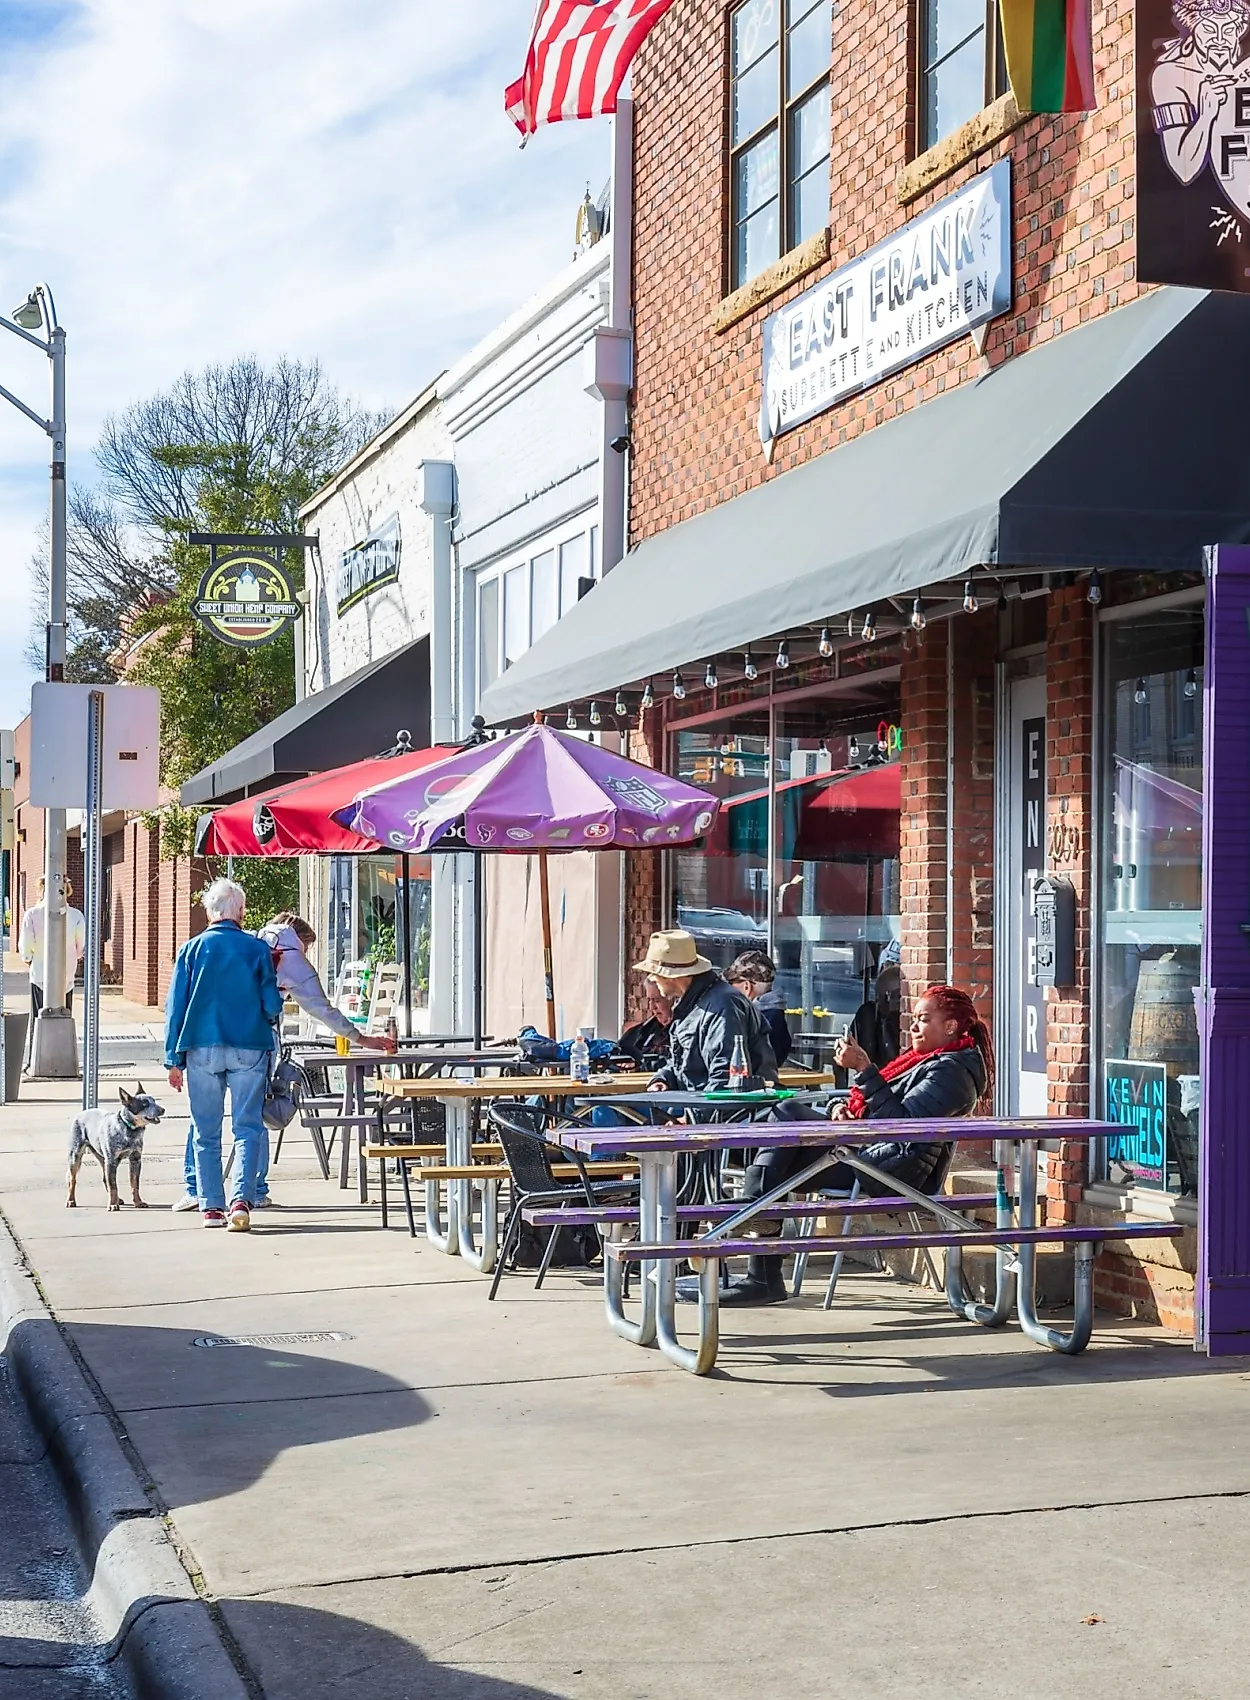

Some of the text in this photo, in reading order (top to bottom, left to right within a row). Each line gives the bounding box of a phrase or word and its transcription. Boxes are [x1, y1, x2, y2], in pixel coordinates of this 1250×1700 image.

[789, 200, 976, 371] EAST FRANK
[878, 330, 901, 357] AND
[906, 270, 989, 347] KITCHEN
[199, 602, 296, 615] SWEET UNION HEMP COMPANY
[1027, 732, 1039, 1052] ENTER
[1108, 1074, 1163, 1107] KEVIN
[1108, 1103, 1163, 1167] DANIELS
